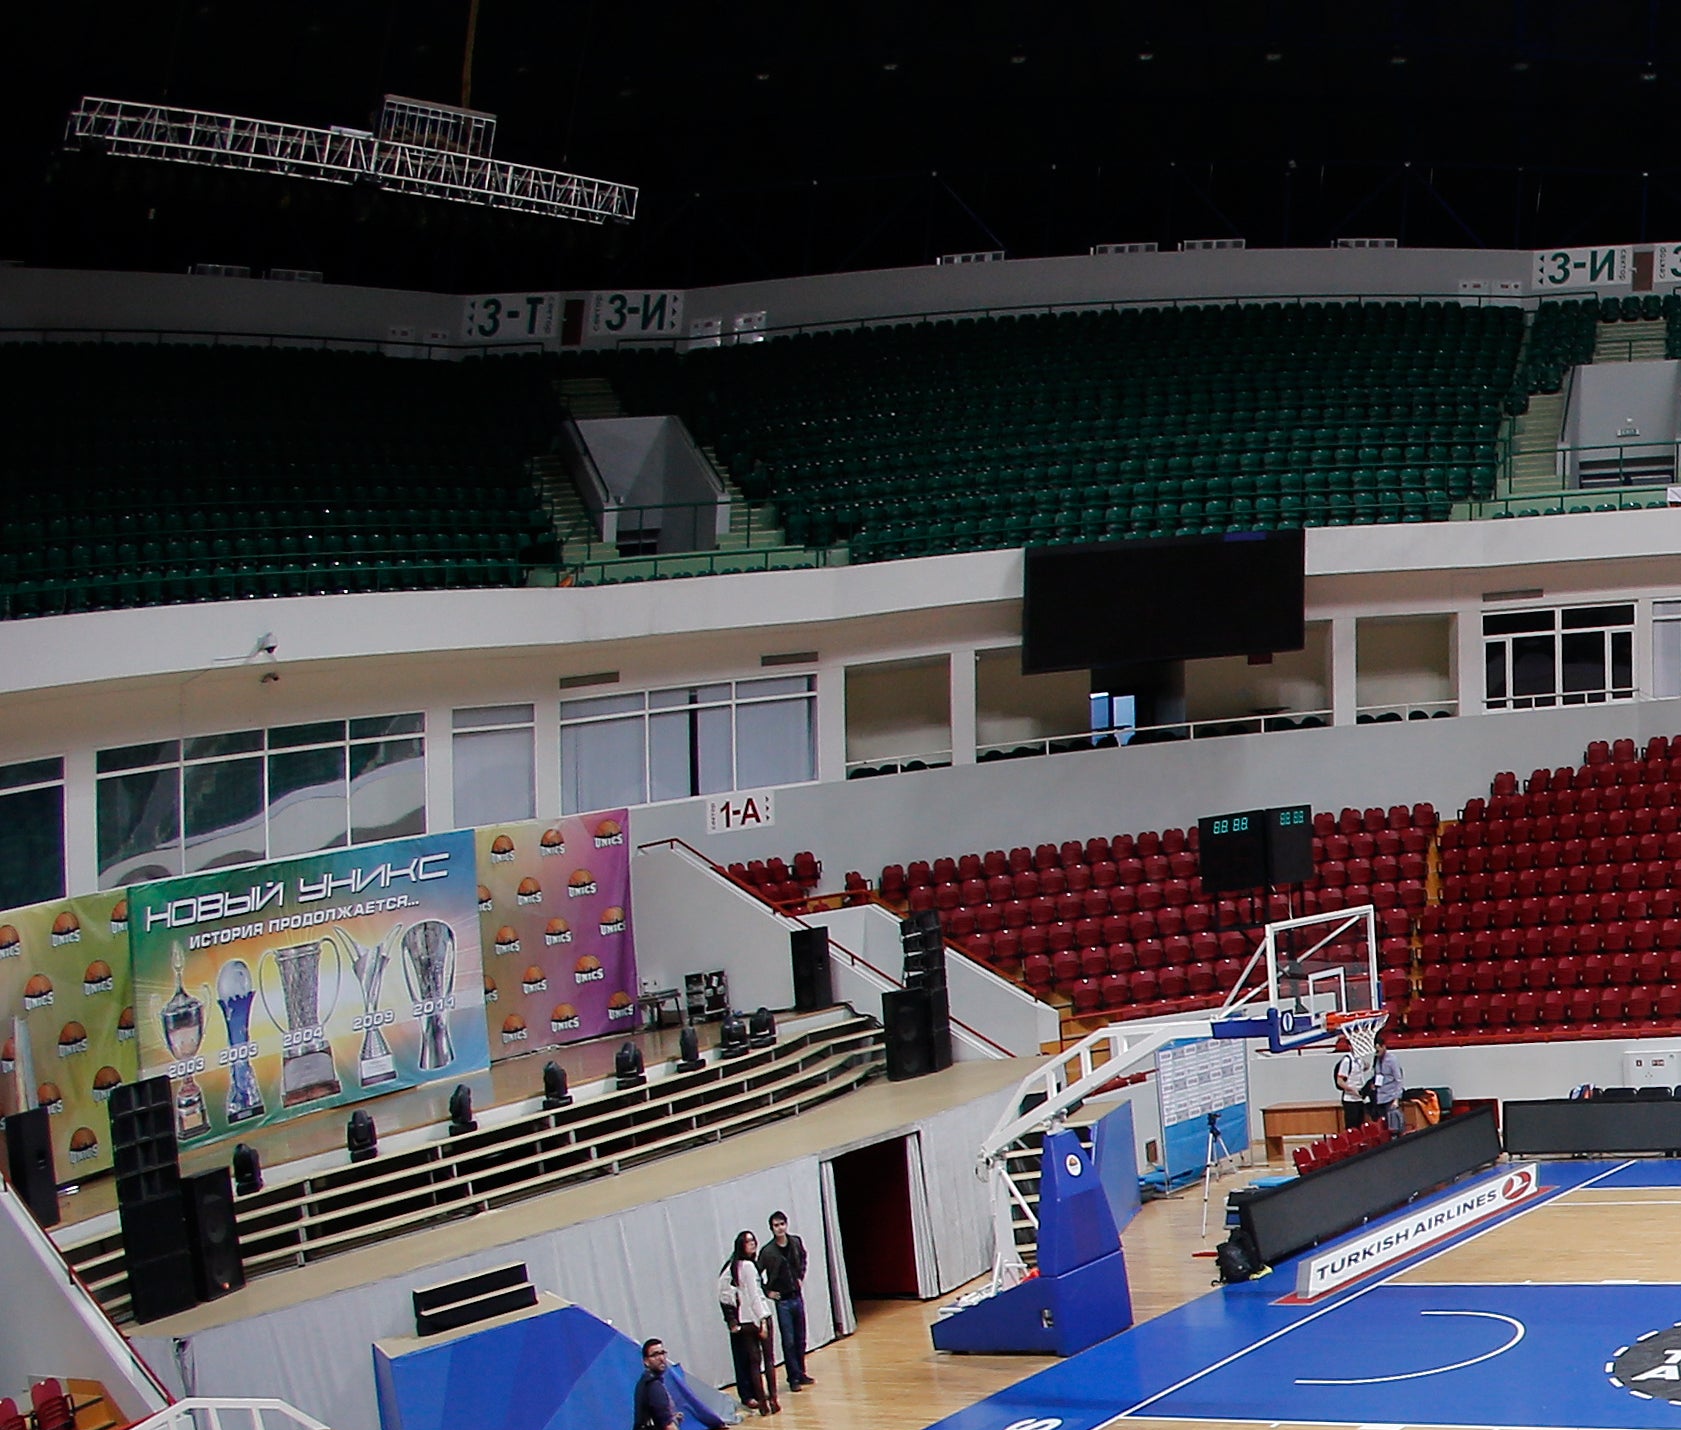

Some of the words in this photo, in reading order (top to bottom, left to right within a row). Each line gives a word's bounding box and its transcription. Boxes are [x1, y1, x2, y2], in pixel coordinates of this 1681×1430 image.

[1548, 249, 1616, 285] 3-И
[478, 297, 544, 337] 3-Т
[605, 293, 668, 332] 3-И
[720, 797, 761, 828] 1-А
[594, 833, 623, 848] UNICS
[145, 880, 285, 932] НОВЫЙ
[298, 853, 450, 903] УНИКС
[517, 892, 542, 906] UNICS
[568, 882, 597, 898] UNICS
[189, 922, 264, 950] ИСТОРИЯ
[575, 968, 605, 984] UNICS
[412, 996, 456, 1017] 2011
[352, 1010, 394, 1031] 2009
[551, 1017, 580, 1032] UNICS
[283, 1027, 324, 1048] 2004
[218, 1043, 259, 1066] 2003
[168, 1057, 205, 1079] 2003
[1316, 1228, 1410, 1280] TURKISH
[1412, 1189, 1498, 1238] AIRLINES
